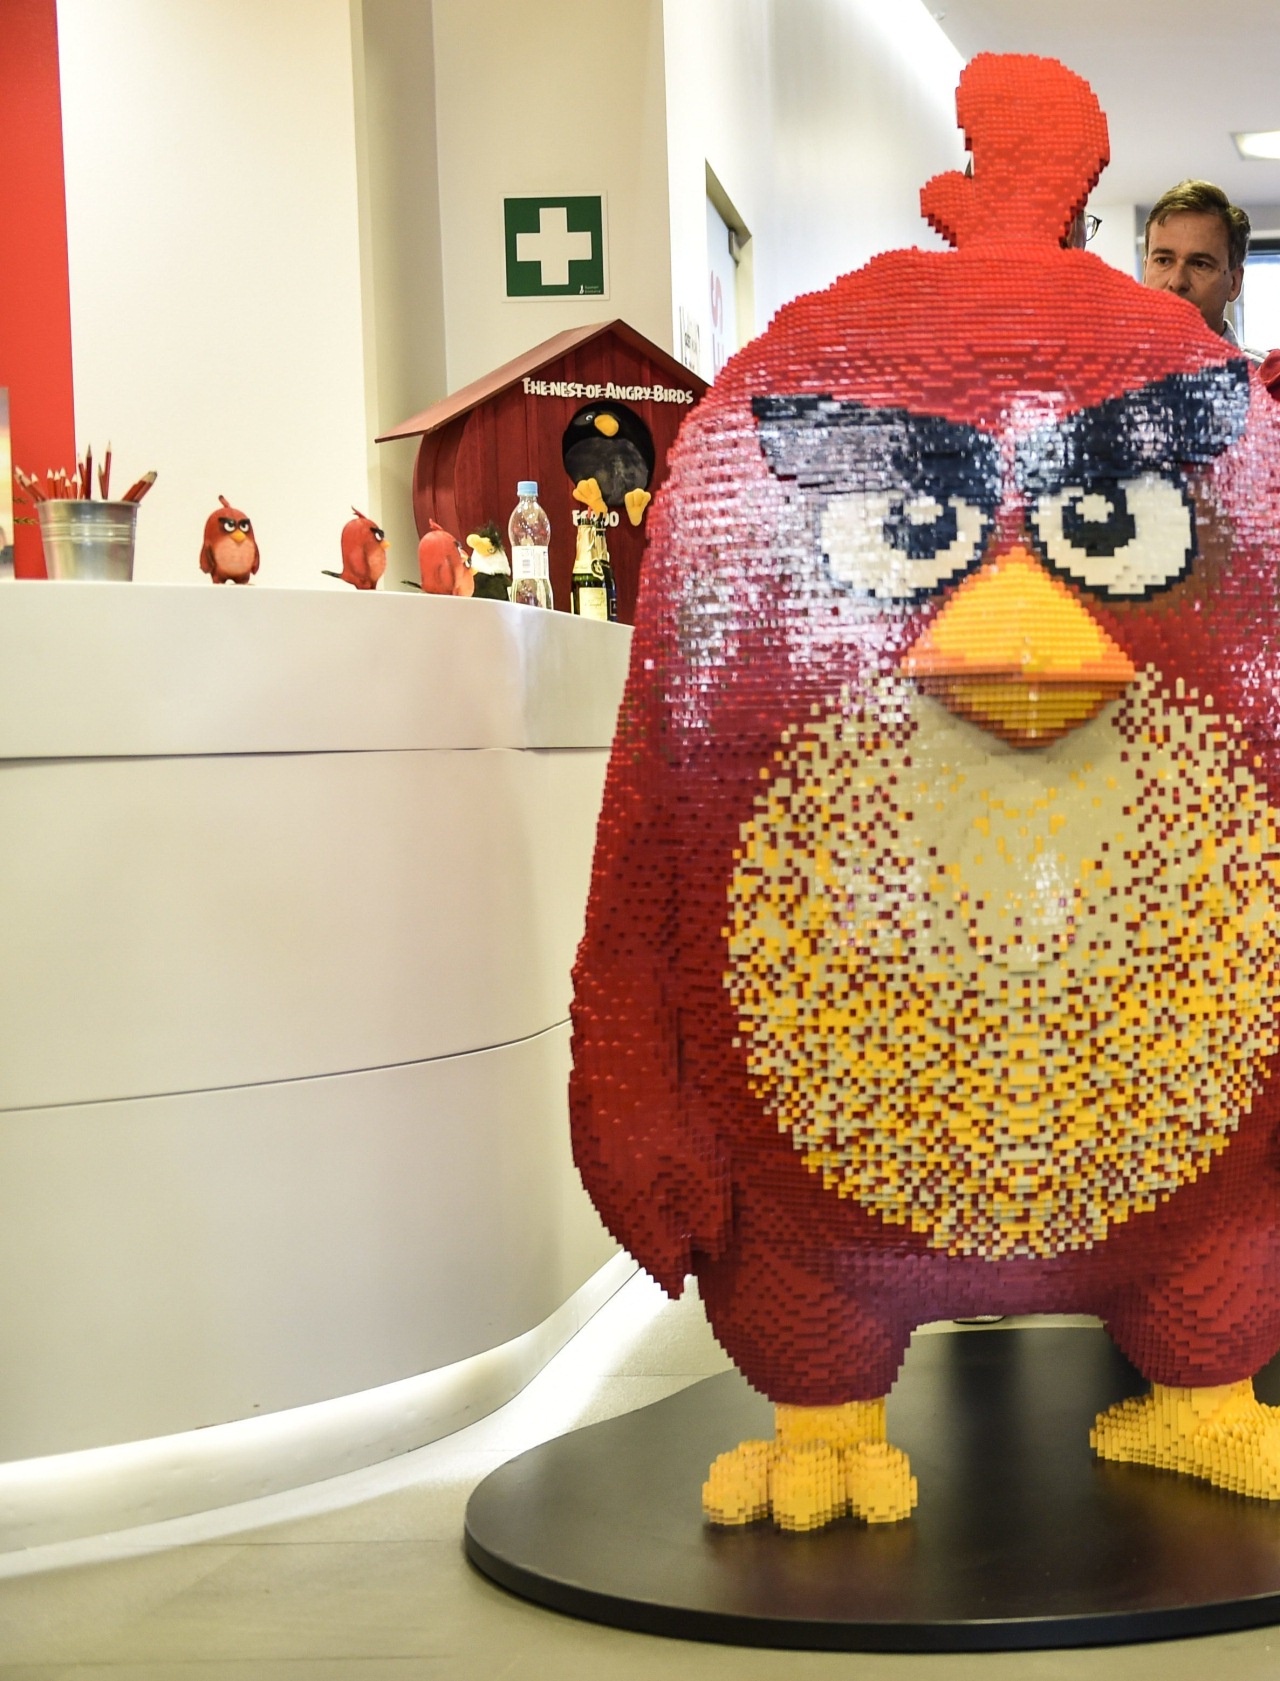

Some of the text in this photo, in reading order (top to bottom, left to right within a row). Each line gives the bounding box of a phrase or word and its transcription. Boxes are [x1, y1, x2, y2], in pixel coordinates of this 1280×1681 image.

[522, 377, 694, 405] THE NEST OF ANGRY BIRDS
